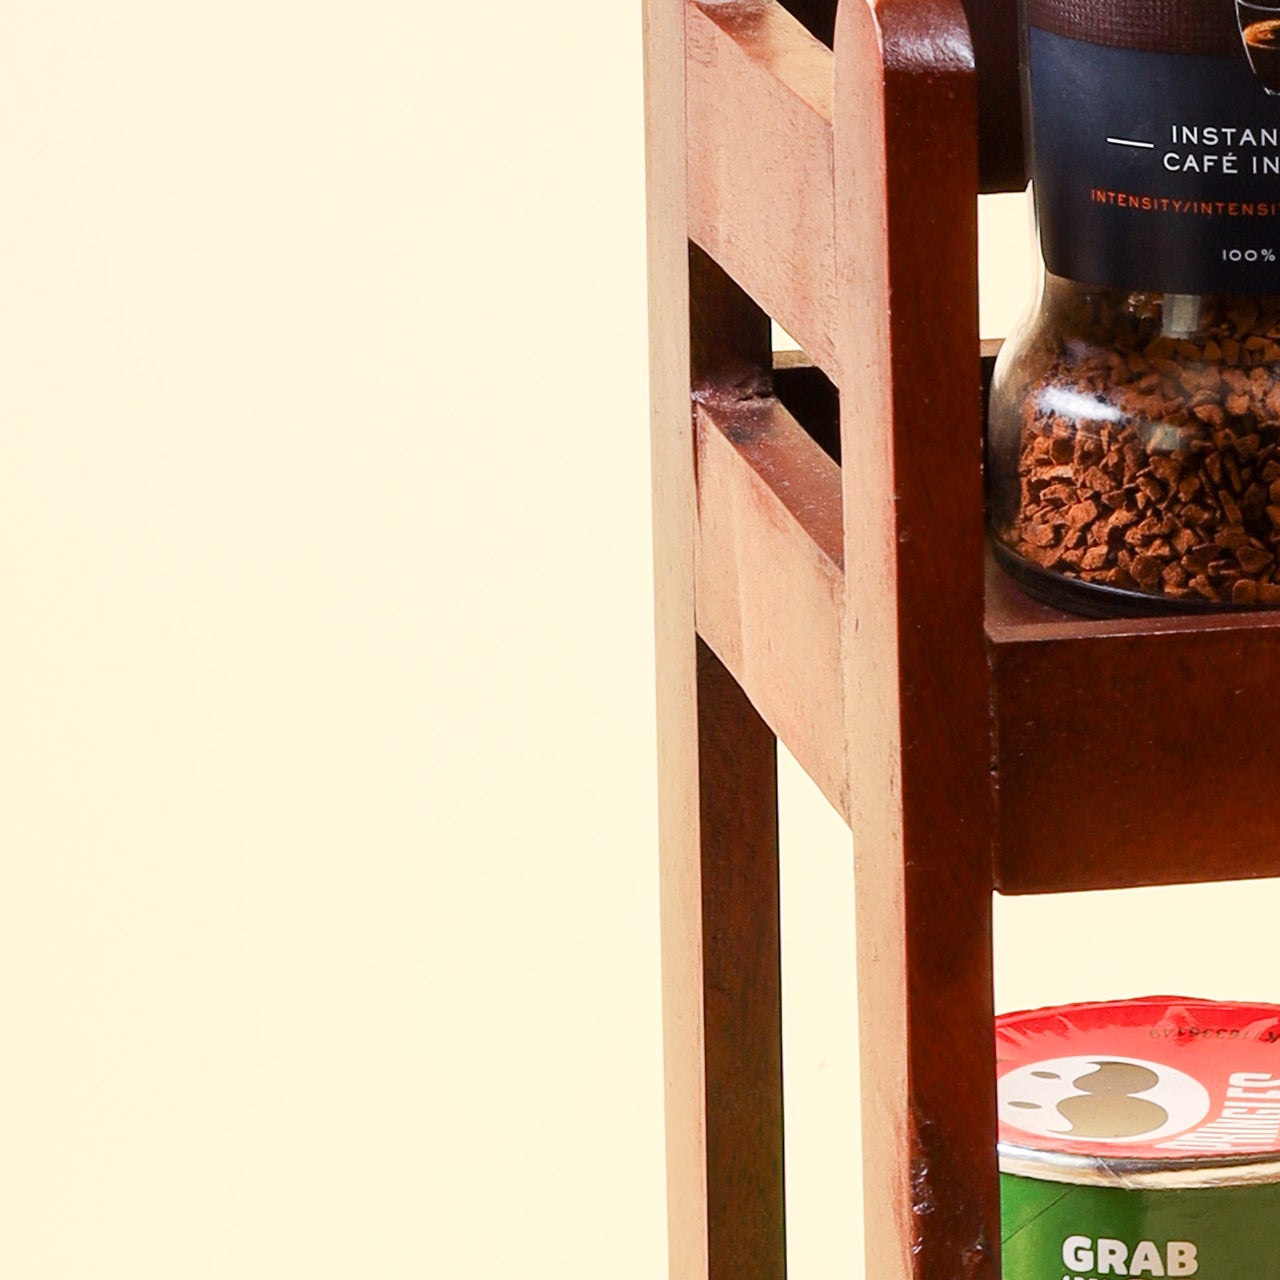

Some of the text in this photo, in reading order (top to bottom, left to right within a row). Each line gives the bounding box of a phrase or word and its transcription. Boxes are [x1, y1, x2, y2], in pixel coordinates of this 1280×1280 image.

[1163, 152, 1238, 174] CAFÉ
[1222, 248, 1276, 262] 100%
[1062, 1235, 1199, 1277] GRAB
